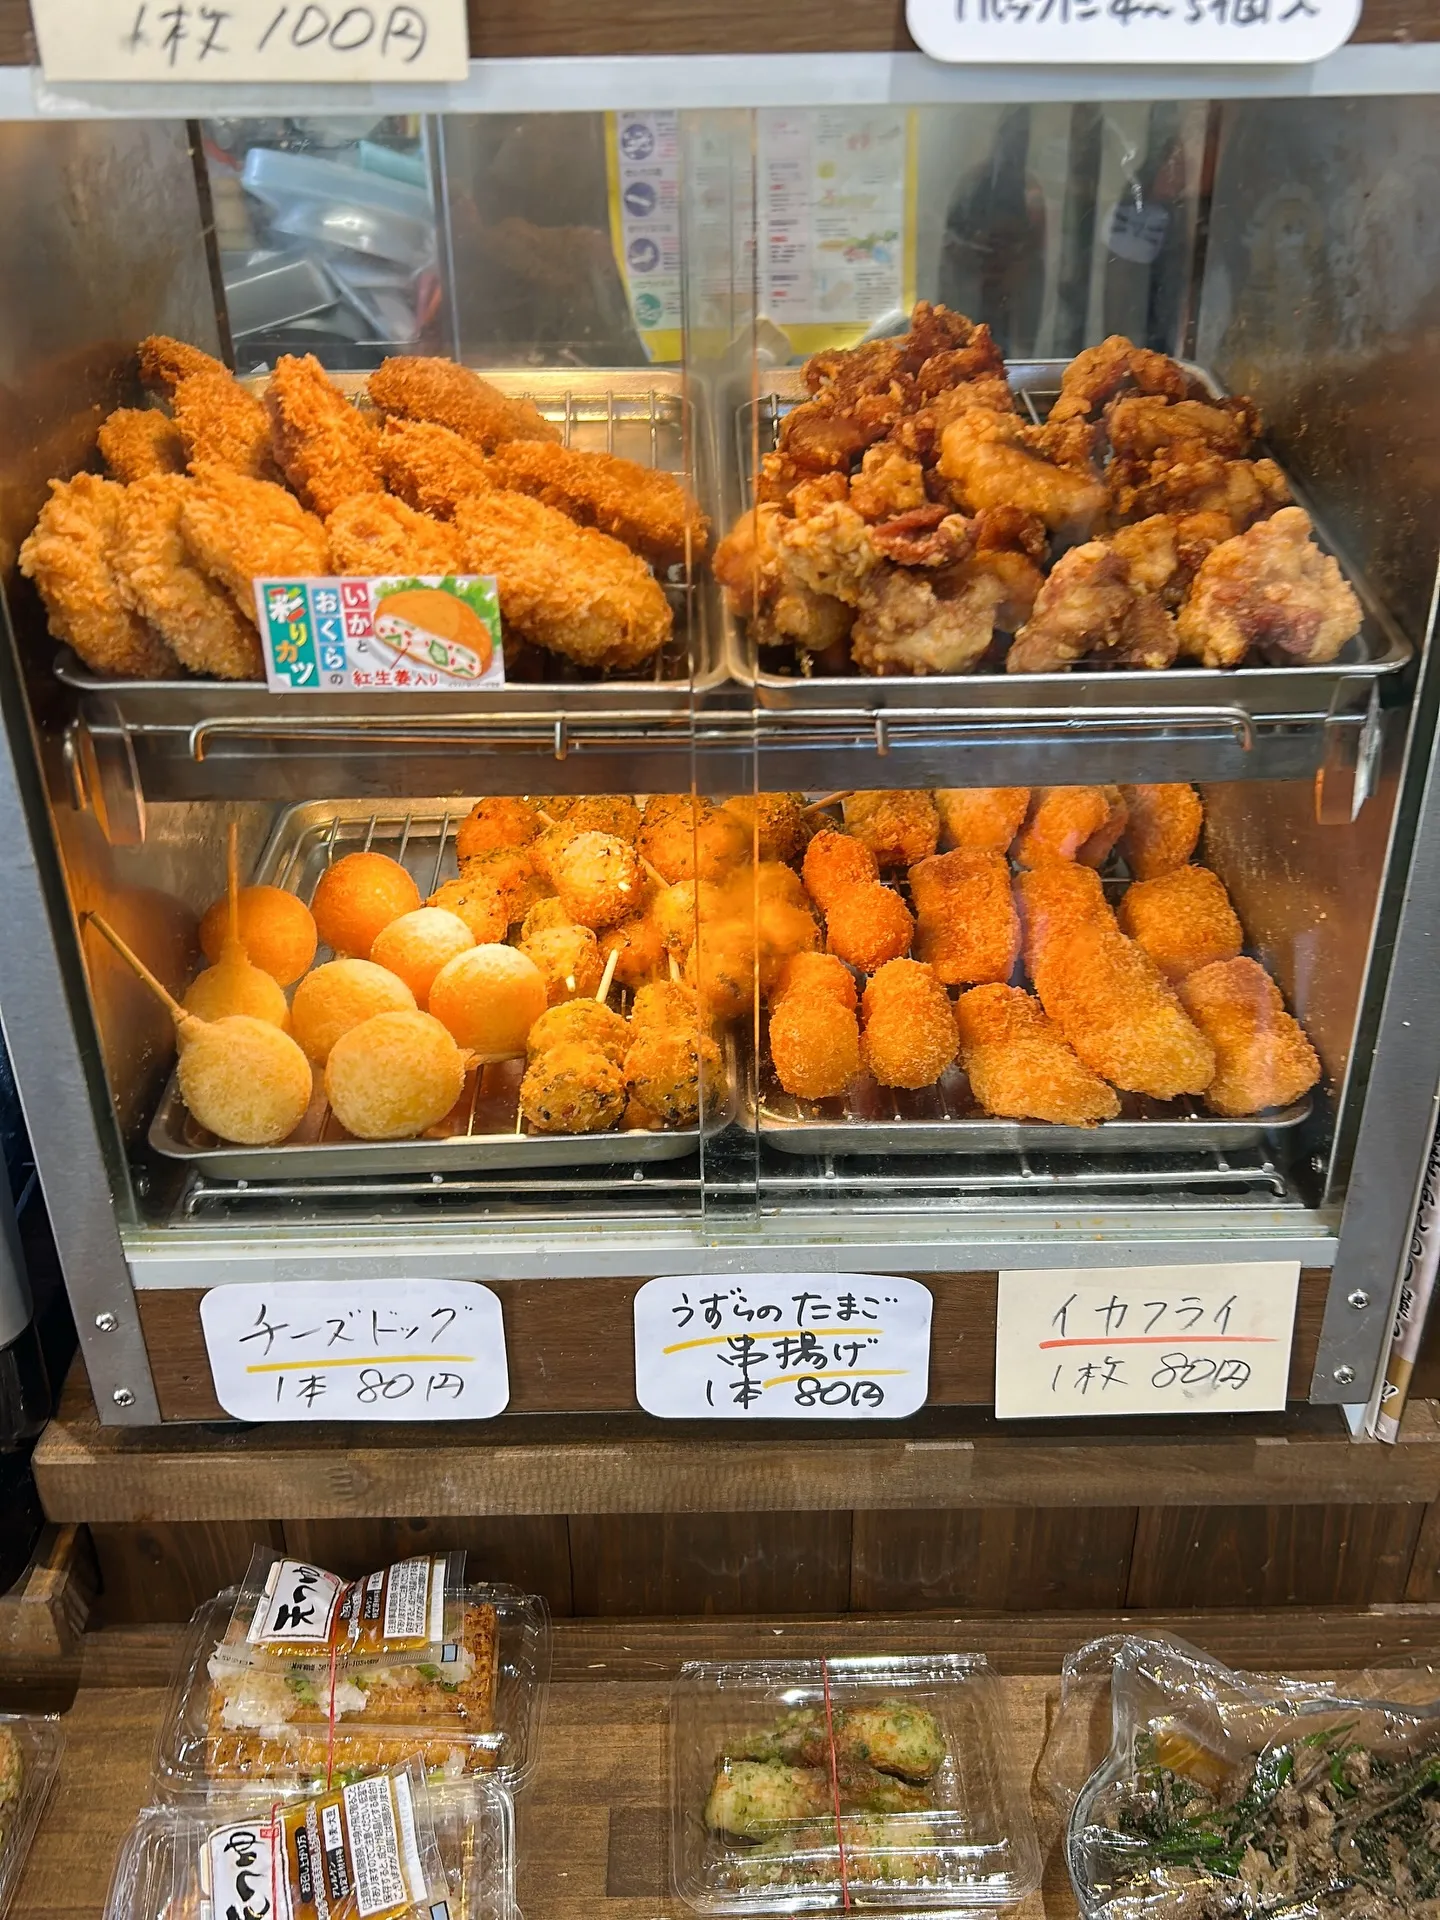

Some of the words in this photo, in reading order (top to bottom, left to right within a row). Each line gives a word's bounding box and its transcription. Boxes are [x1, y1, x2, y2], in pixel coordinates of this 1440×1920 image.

[256, 3, 428, 63] 100円
[268, 587, 315, 685] 彩りカツ
[315, 591, 345, 685] おくらの
[239, 1303, 473, 1356] チーズドッグ
[1051, 1293, 1238, 1337] イカフライ
[717, 1331, 879, 1376] 串揚げ
[1151, 1352, 1252, 1390] 80円
[276, 1374, 328, 1408] 1本
[356, 1368, 465, 1404] 80円
[706, 1376, 763, 1410] 1本
[794, 1376, 885, 1408] 80円
[273, 1565, 321, 1633] 天つゆ
